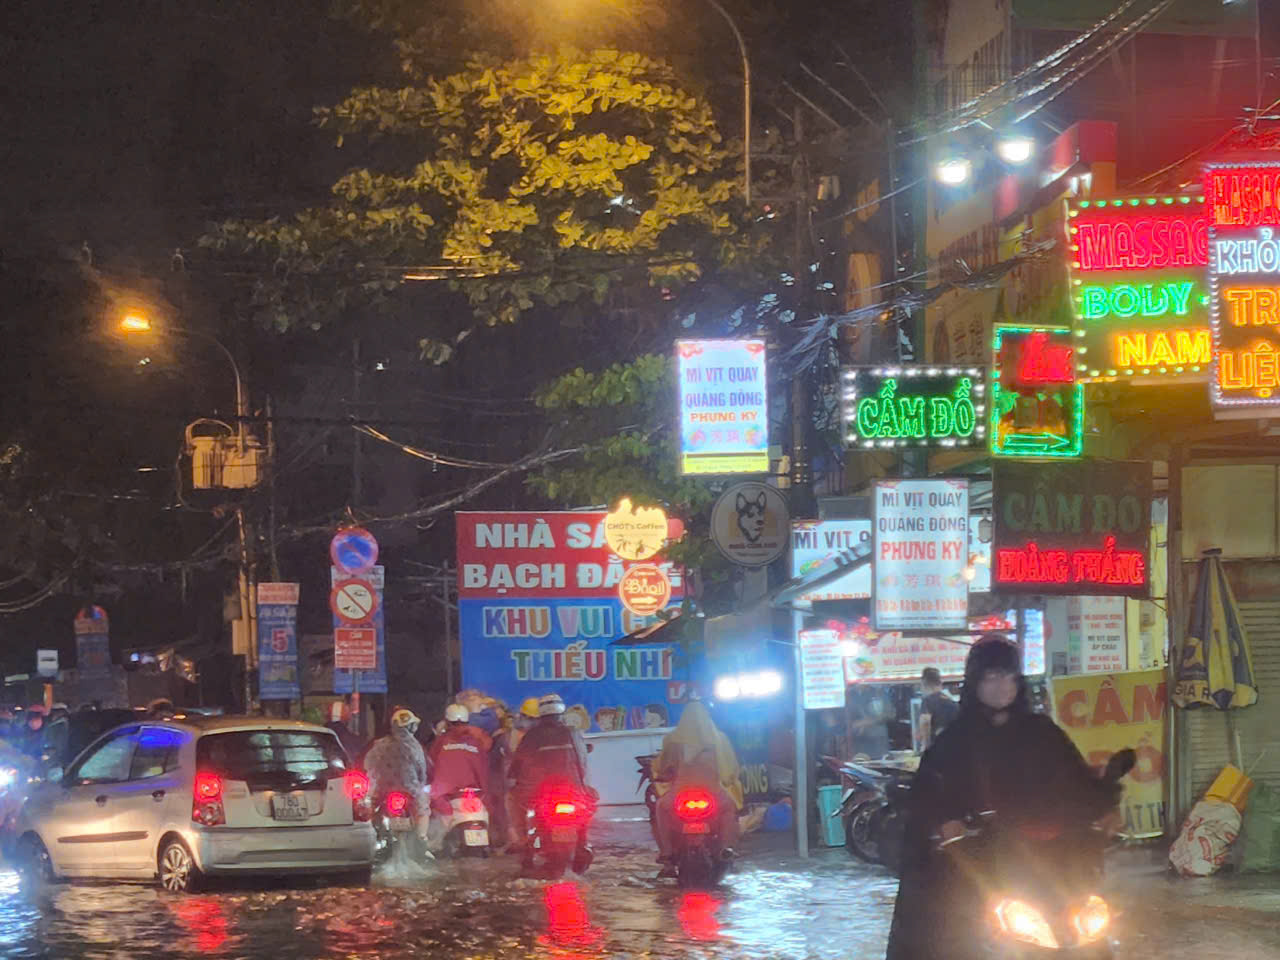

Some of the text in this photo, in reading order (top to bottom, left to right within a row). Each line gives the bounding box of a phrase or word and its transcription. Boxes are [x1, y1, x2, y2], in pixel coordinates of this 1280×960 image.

[1079, 219, 1208, 271] MASSAG
[1084, 282, 1194, 319] BODY
[1119, 331, 1211, 367] NAM
[705, 367, 724, 386] VỊT
[728, 366, 759, 383] QUAY
[857, 377, 926, 438] CẦM
[931, 377, 977, 438] ĐỒ
[882, 491, 963, 510] MÌ VỊT QUAY
[475, 518, 556, 549] NHÀ
[794, 527, 818, 550] MÌ
[879, 514, 967, 533] QUẢNG ĐÔNG
[880, 540, 936, 565] PHỤNG
[997, 535, 1146, 585] HOÀNG THẮNG
[463, 563, 566, 594] BẠCH
[482, 606, 552, 638] KHU
[556, 606, 615, 638] VUI
[271, 628, 289, 652] 5
[511, 640, 673, 681] THIẾU NHI
[1058, 675, 1166, 728] CẦM
